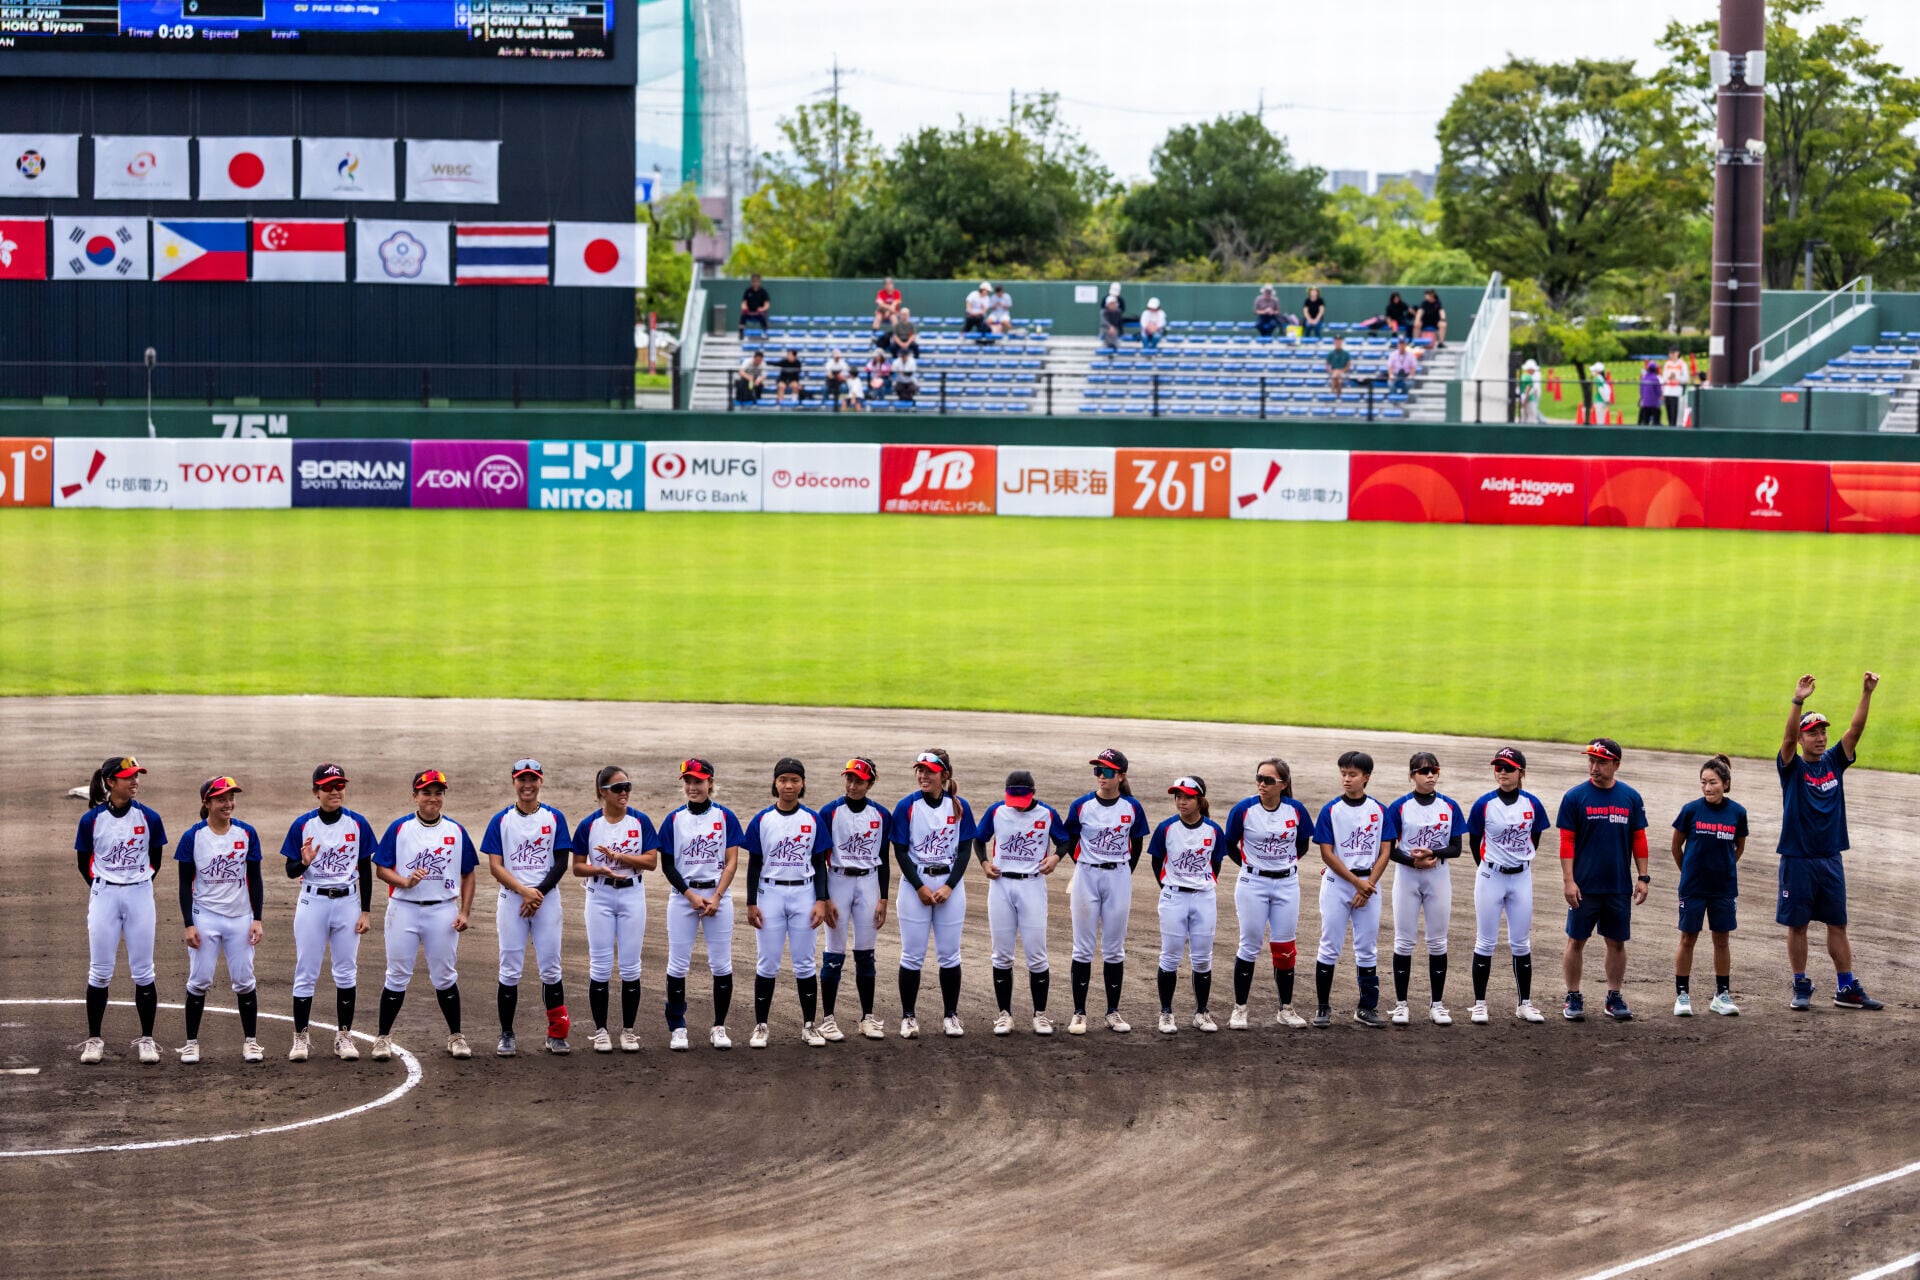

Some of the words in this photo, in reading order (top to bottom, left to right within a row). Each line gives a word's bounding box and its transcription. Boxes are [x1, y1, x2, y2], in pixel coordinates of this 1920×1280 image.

[1, 8, 23, 18] KIM
[27, 8, 60, 21] Jiyun
[490, 4, 529, 13] WONG
[551, 4, 587, 16] Ching
[1, 20, 39, 31] HONG
[42, 20, 84, 34] Siyeon
[489, 16, 520, 26] CHIU
[128, 27, 153, 38] Time
[158, 24, 194, 39] 0:03
[202, 28, 239, 40] Speed
[489, 29, 514, 39] LAU
[516, 29, 546, 39] Suet
[547, 29, 574, 39] Man
[431, 164, 472, 176] WBSC
[541, 443, 633, 481] ニトリ
[691, 457, 757, 476] MUFG
[178, 463, 285, 483] TOYOTA
[298, 461, 405, 479] BORNAN
[900, 450, 975, 495] JTB
[106, 477, 168, 493] 中部電力
[301, 480, 338, 490] SPORTS
[341, 480, 404, 491] TECHNOLOGY
[795, 472, 870, 488] docomo
[1004, 469, 1108, 495] JR東海
[1481, 478, 1574, 496] Aichi-Nagoya
[541, 488, 633, 509] NITORI
[660, 489, 707, 503] MUFG
[711, 490, 748, 503] Bank
[1281, 488, 1343, 503] 中部電力
[1509, 493, 1544, 506] 2026
[1586, 806, 1608, 815] Hong
[1609, 805, 1629, 816] Kong
[1609, 814, 1628, 824] China
[1696, 821, 1717, 831] Hong
[1717, 823, 1736, 834] Kong
